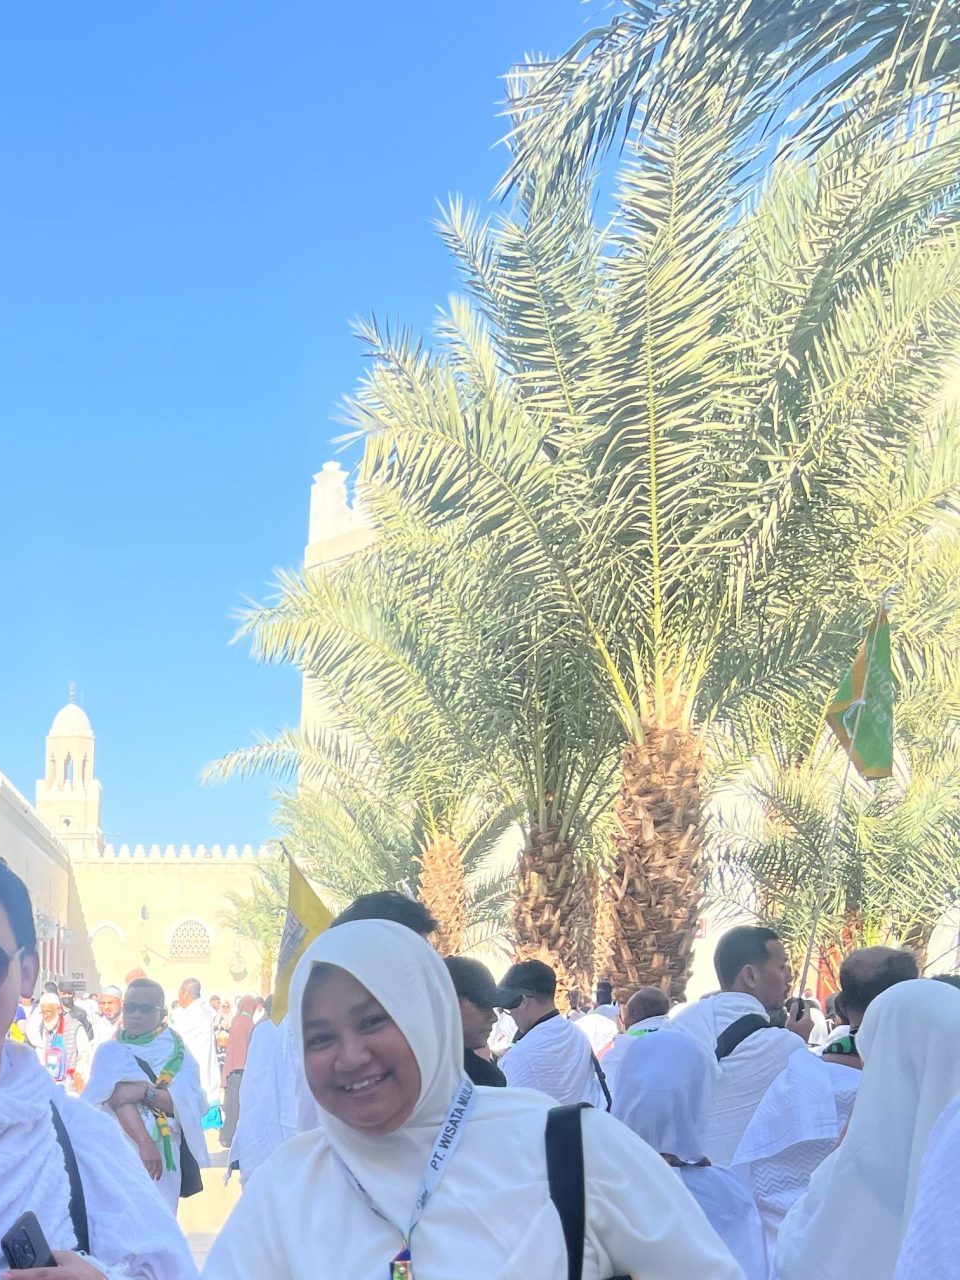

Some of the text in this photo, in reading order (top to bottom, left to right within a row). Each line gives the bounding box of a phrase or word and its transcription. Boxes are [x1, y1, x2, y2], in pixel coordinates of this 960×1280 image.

[430, 1080, 474, 1171] PT. WISATA MULI
